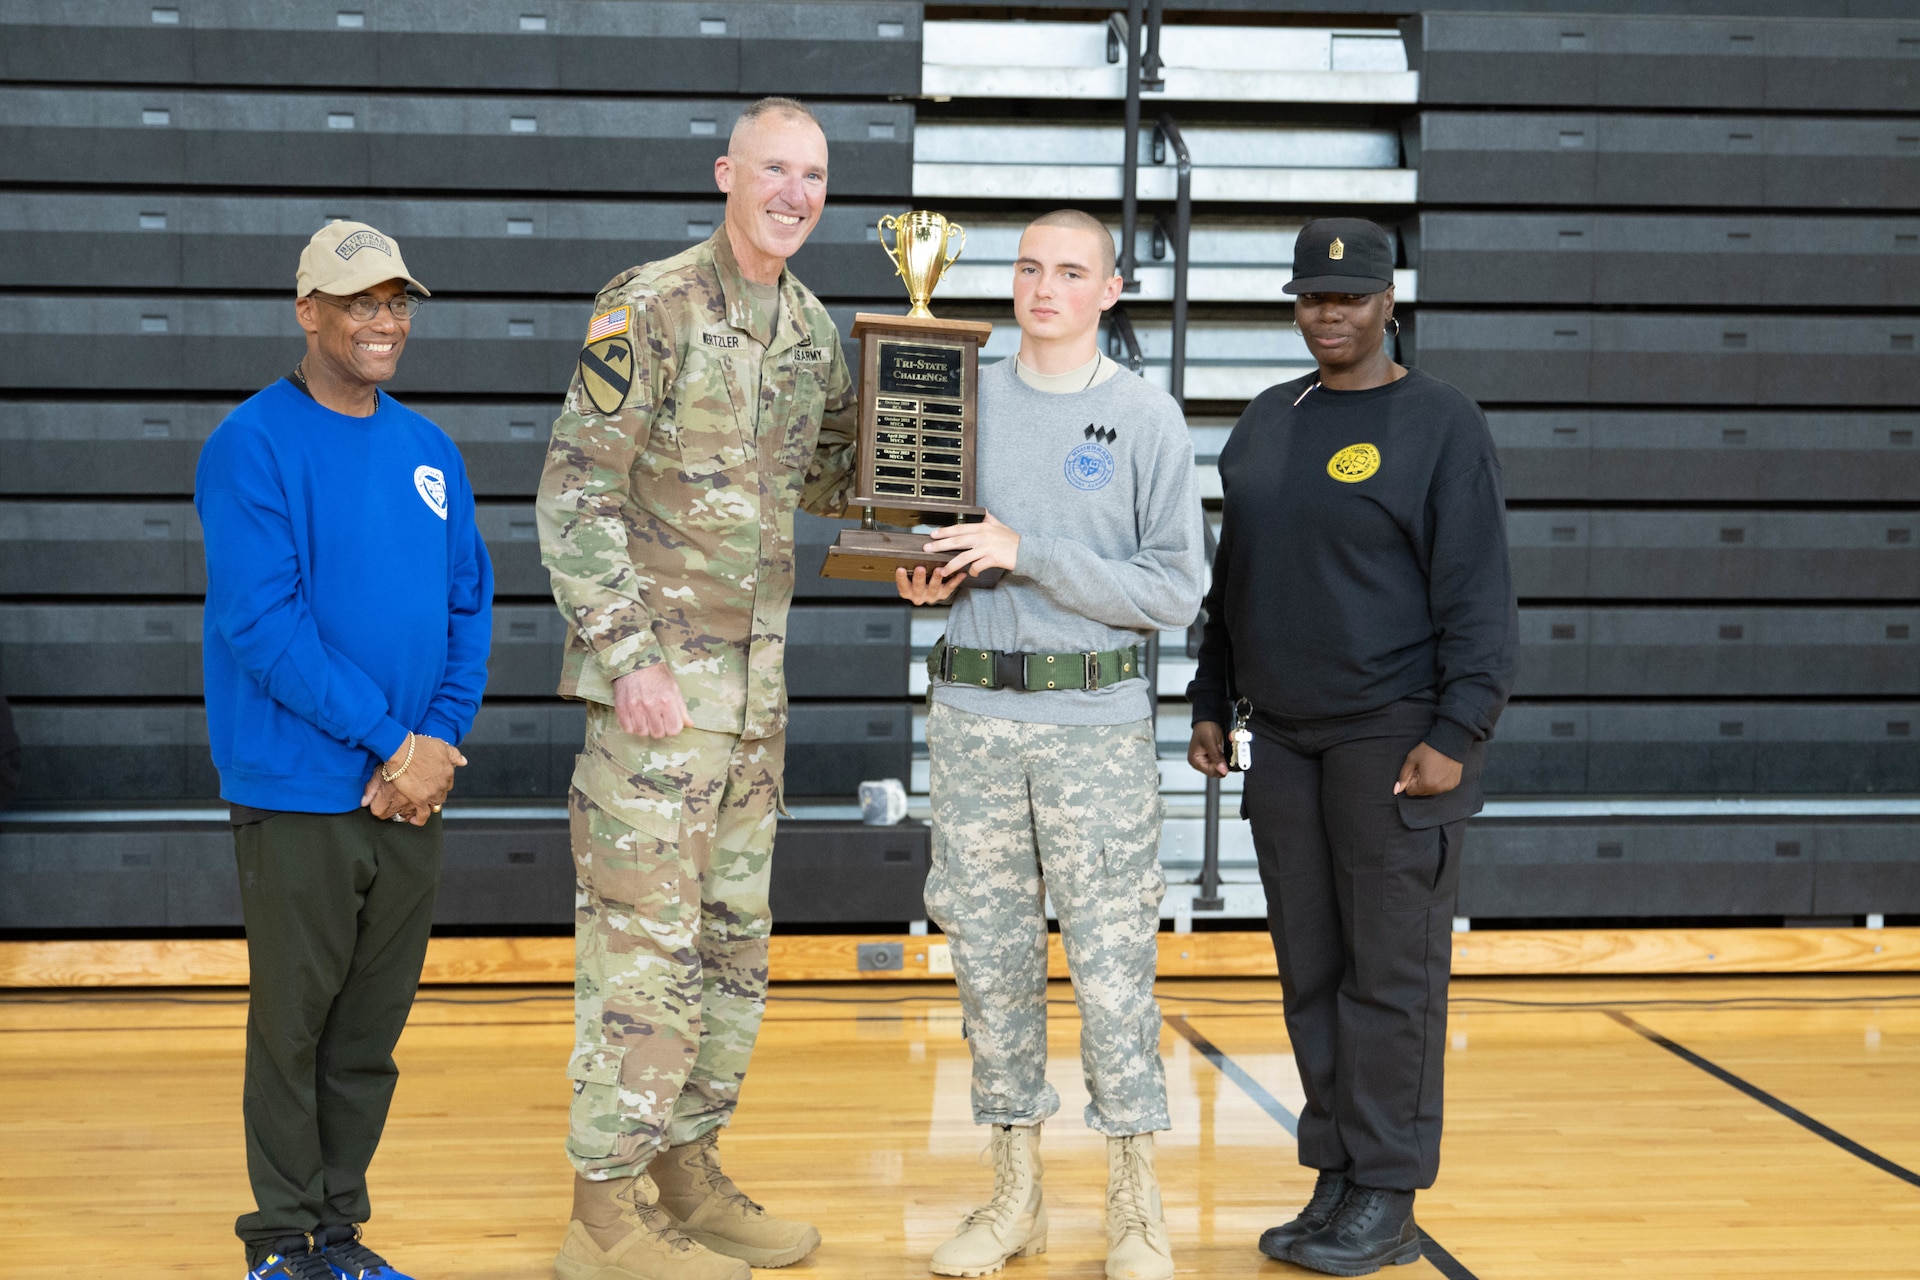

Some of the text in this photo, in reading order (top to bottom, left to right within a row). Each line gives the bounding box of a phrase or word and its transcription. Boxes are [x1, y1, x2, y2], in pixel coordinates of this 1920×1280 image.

[801, 350, 822, 361] ARMY
[893, 357, 948, 372] TRI-STATE
[892, 370, 948, 383] CHALLENGE
